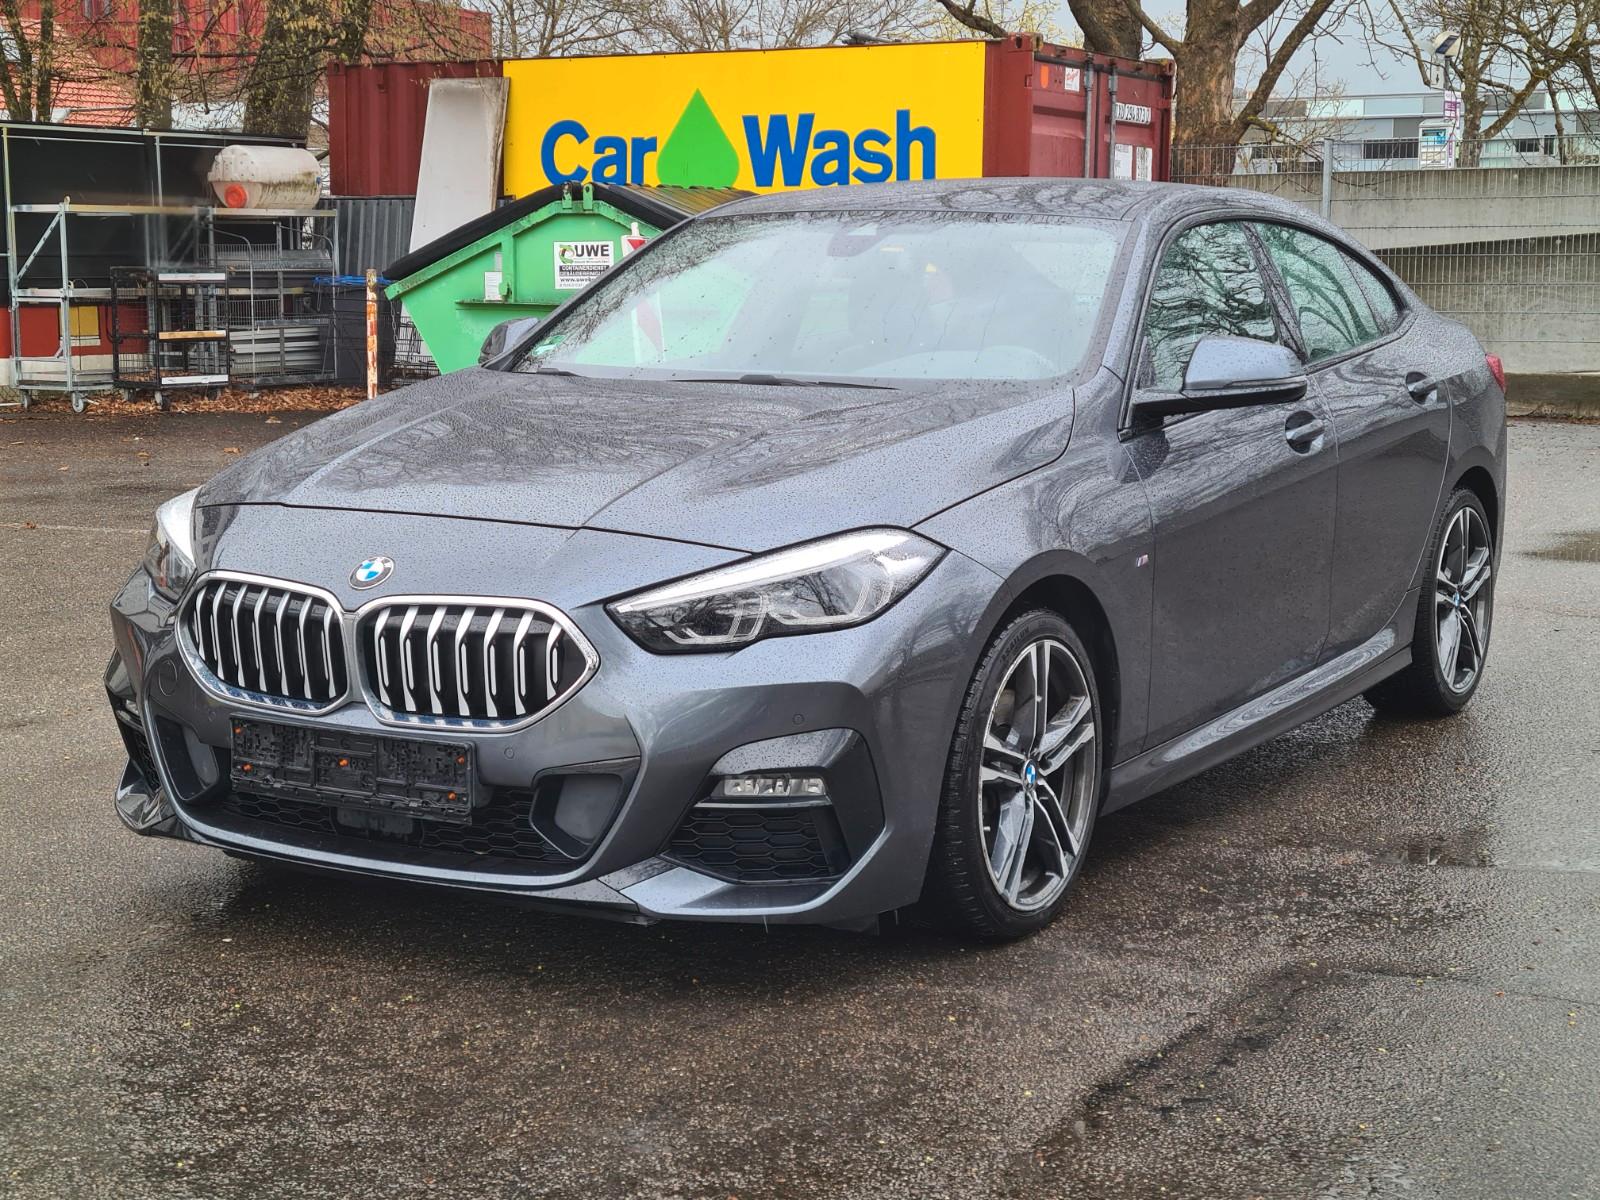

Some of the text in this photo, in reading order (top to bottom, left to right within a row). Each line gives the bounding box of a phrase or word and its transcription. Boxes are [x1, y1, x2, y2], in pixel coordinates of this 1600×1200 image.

[541, 109, 936, 187] Car Wash
[575, 244, 609, 257] UWE
